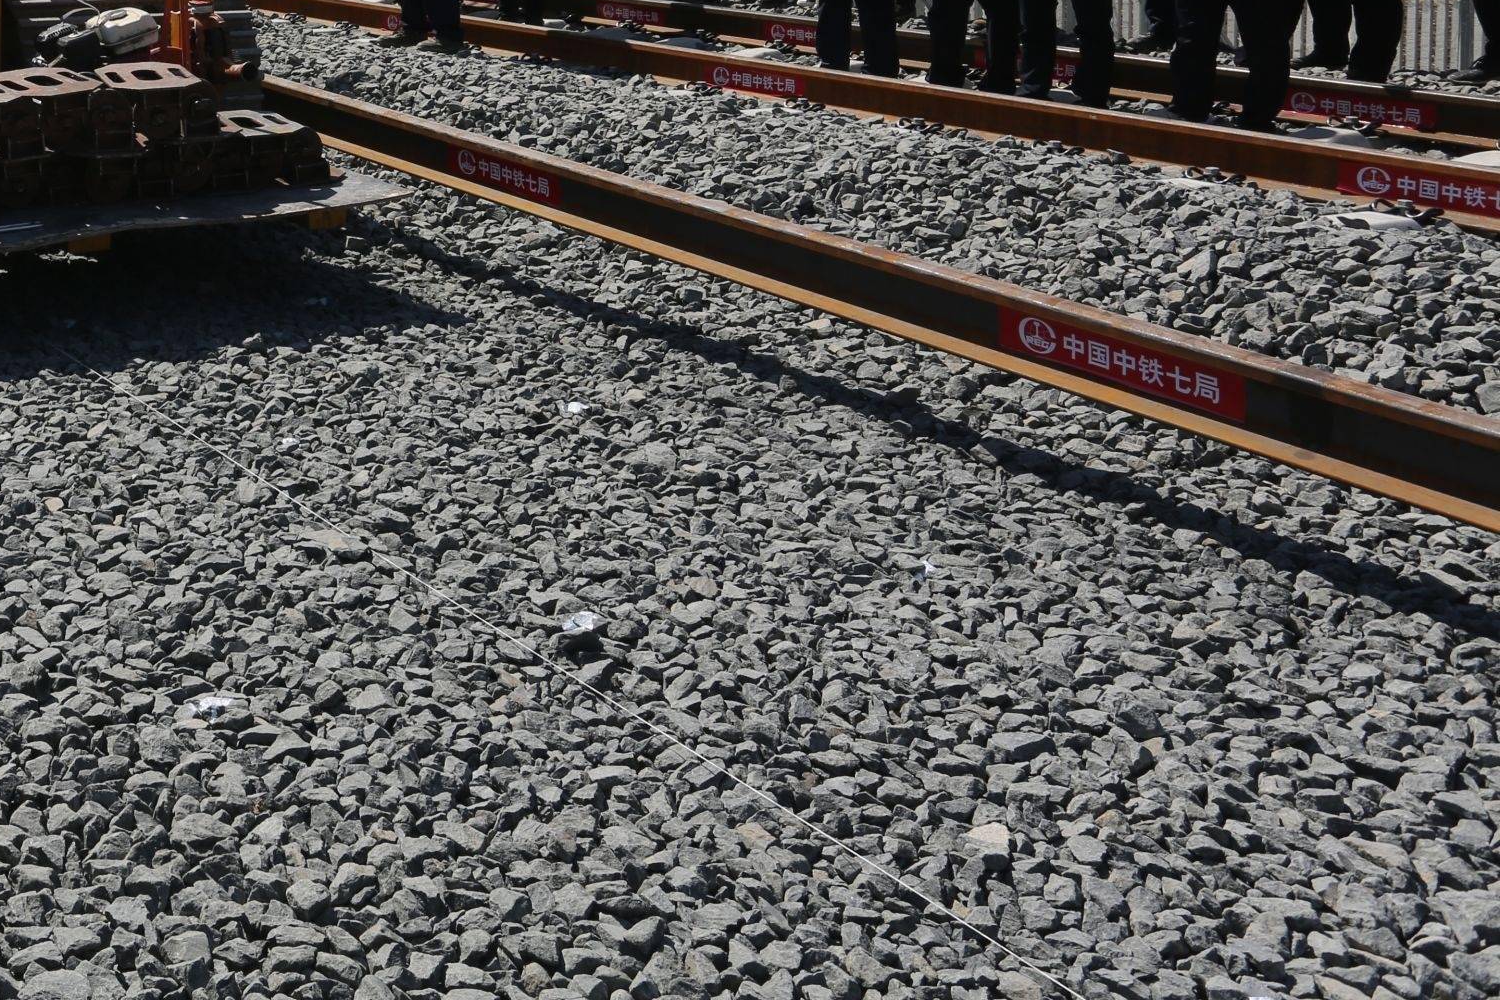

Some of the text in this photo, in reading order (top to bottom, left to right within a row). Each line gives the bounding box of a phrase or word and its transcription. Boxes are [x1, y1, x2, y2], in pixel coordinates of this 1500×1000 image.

[786, 22, 817, 41] 中国中
[731, 71, 796, 94] 中国中铁七局
[1320, 98, 1421, 125] 中国中铁七局
[478, 158, 550, 198] 中国中铁七局
[1063, 333, 1220, 404] 中国中铁七局
